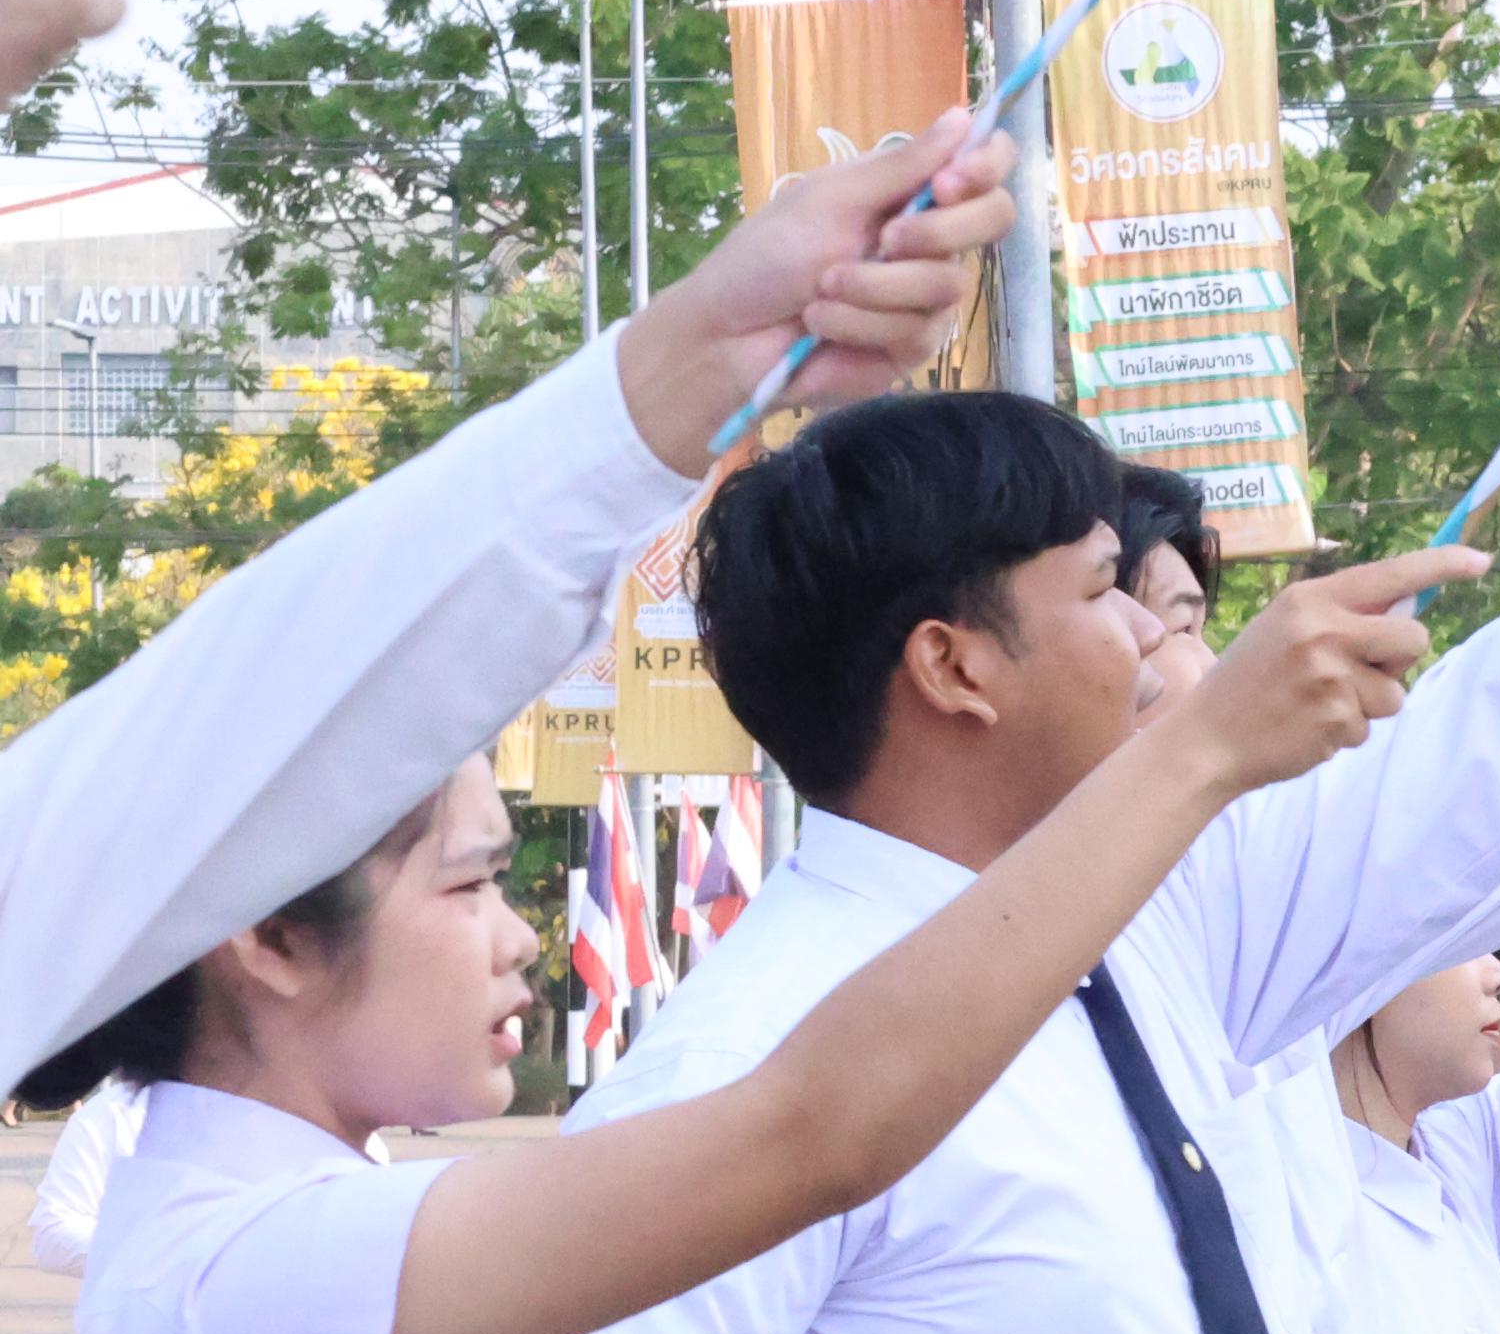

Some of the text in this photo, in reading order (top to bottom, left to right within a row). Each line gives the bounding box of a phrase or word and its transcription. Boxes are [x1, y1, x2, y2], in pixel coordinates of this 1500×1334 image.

[1071, 136, 1273, 186] วิศวกรสังคม
[1118, 220, 1236, 250] ฟ้าประทาน
[75, 284, 226, 326] ACTIVIT
[1119, 281, 1243, 316] นาฬิกาชีวิต
